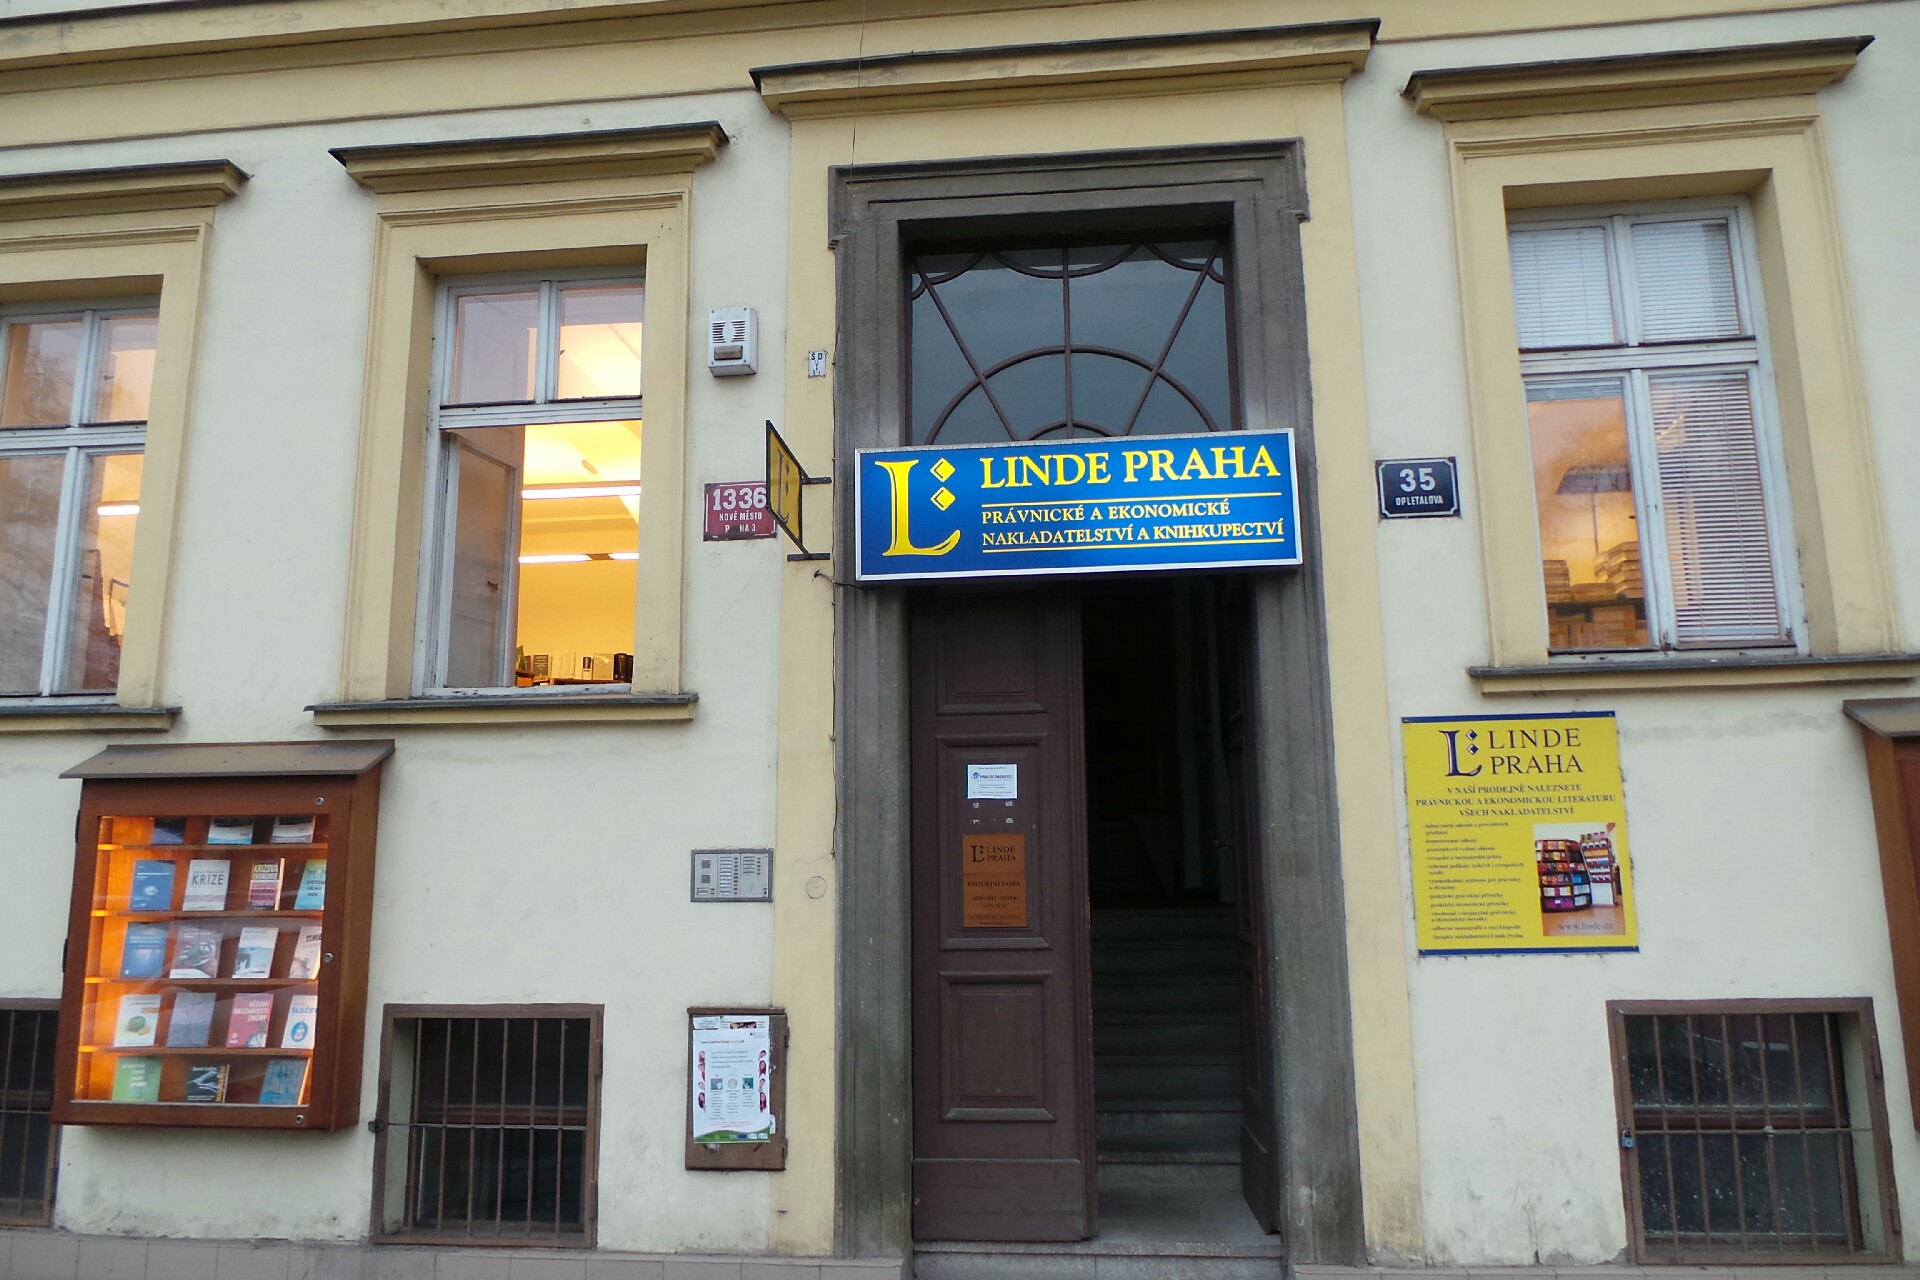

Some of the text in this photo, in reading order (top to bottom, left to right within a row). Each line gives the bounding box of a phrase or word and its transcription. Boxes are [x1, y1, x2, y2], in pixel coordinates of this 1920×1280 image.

[979, 445, 1281, 489] LINDE PRAHA
[1400, 467, 1436, 492] 35
[713, 487, 767, 511] 1336
[1395, 495, 1444, 506] OPLETALOVA
[719, 509, 763, 522] NOVÉ MĚSTO
[981, 497, 1231, 525] PRÁVNICKÉ A EKONOMICKÉ
[725, 523, 756, 533] PHA 3
[981, 517, 1286, 547] NAKLADATELSTVÍ A KNIHKUPECTVÍ
[1488, 728, 1582, 750] LINDE
[1490, 754, 1584, 775] PRAHA
[1477, 783, 1526, 795] PRODEJNĚ
[1528, 783, 1583, 792] NALEZNETE
[1484, 795, 1555, 805] EKONOMICKOU
[1557, 794, 1616, 804] LITERATURU
[1459, 805, 1575, 817] VŠECH NAKLADATELSTVÍ
[987, 854, 1016, 862] PRAHA
[191, 874, 225, 886] KRIZE
